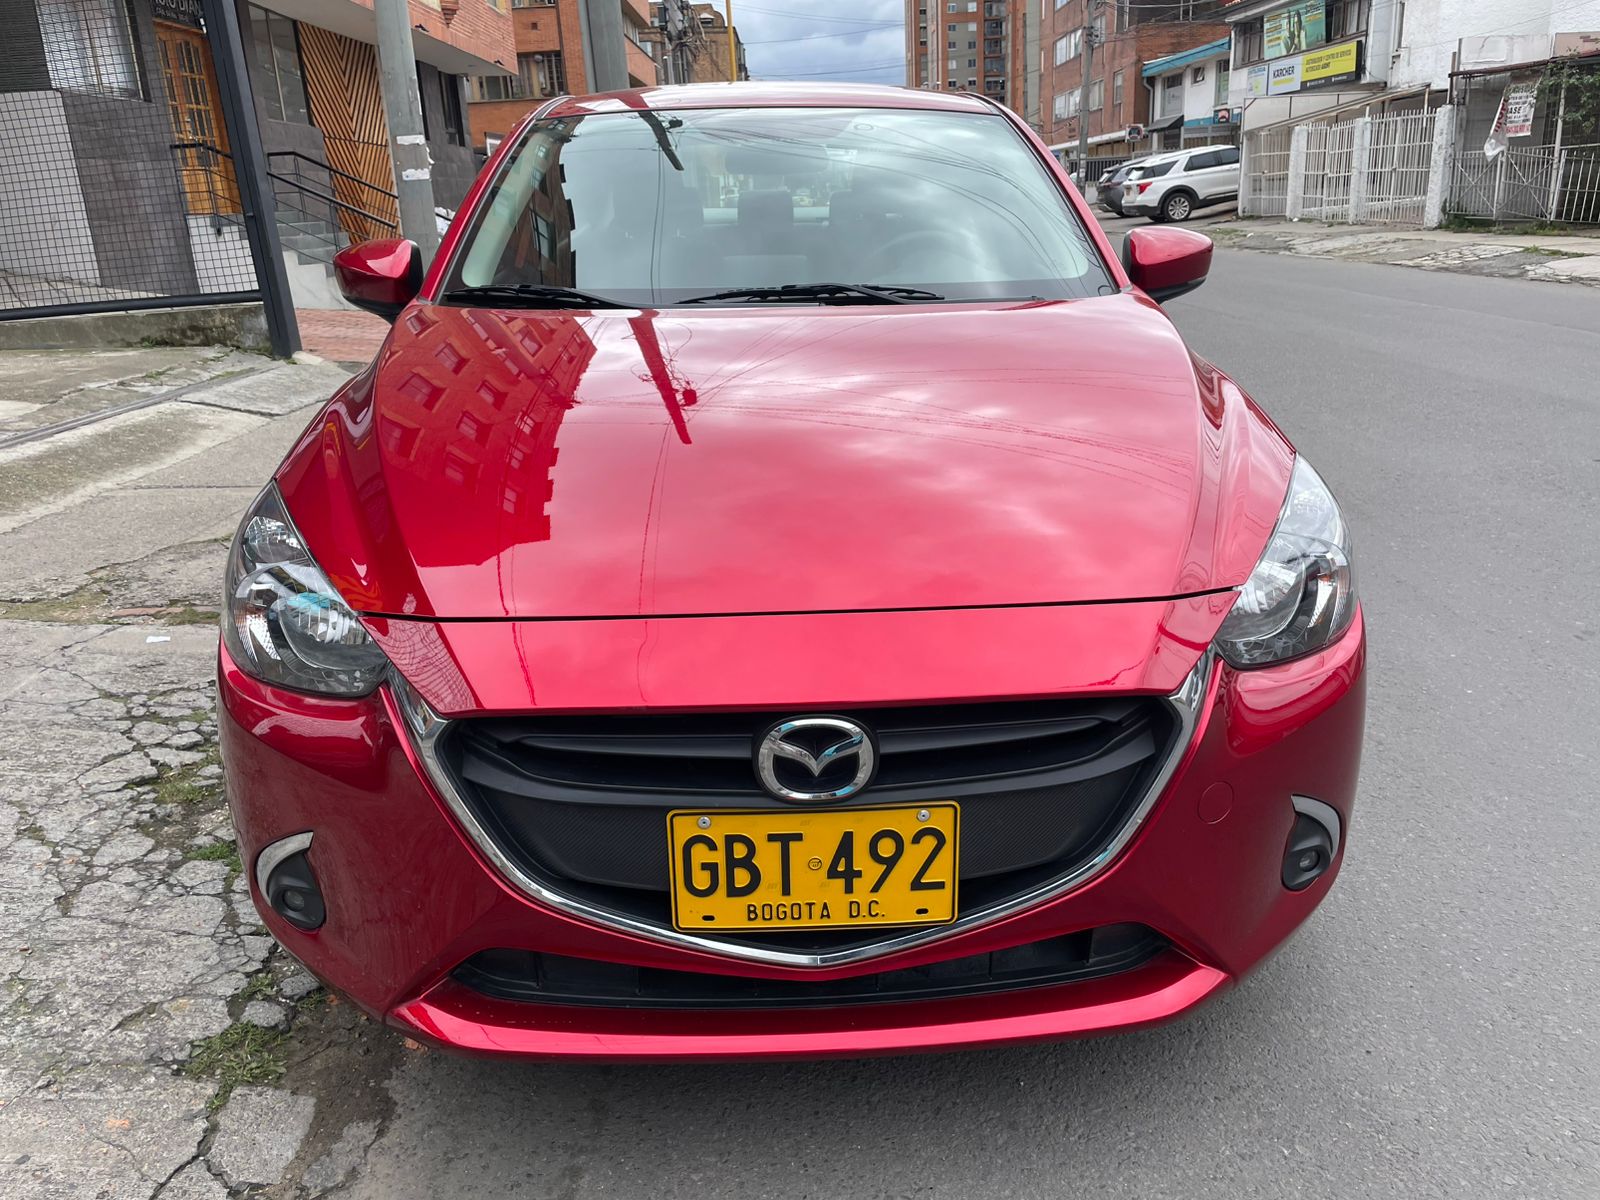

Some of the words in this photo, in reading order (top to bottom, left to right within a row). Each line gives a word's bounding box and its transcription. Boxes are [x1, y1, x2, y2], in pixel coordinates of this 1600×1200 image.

[682, 832, 804, 898] GBT
[826, 827, 947, 894] 492
[747, 902, 831, 921] BOGOTA
[849, 900, 886, 918] D.C.
